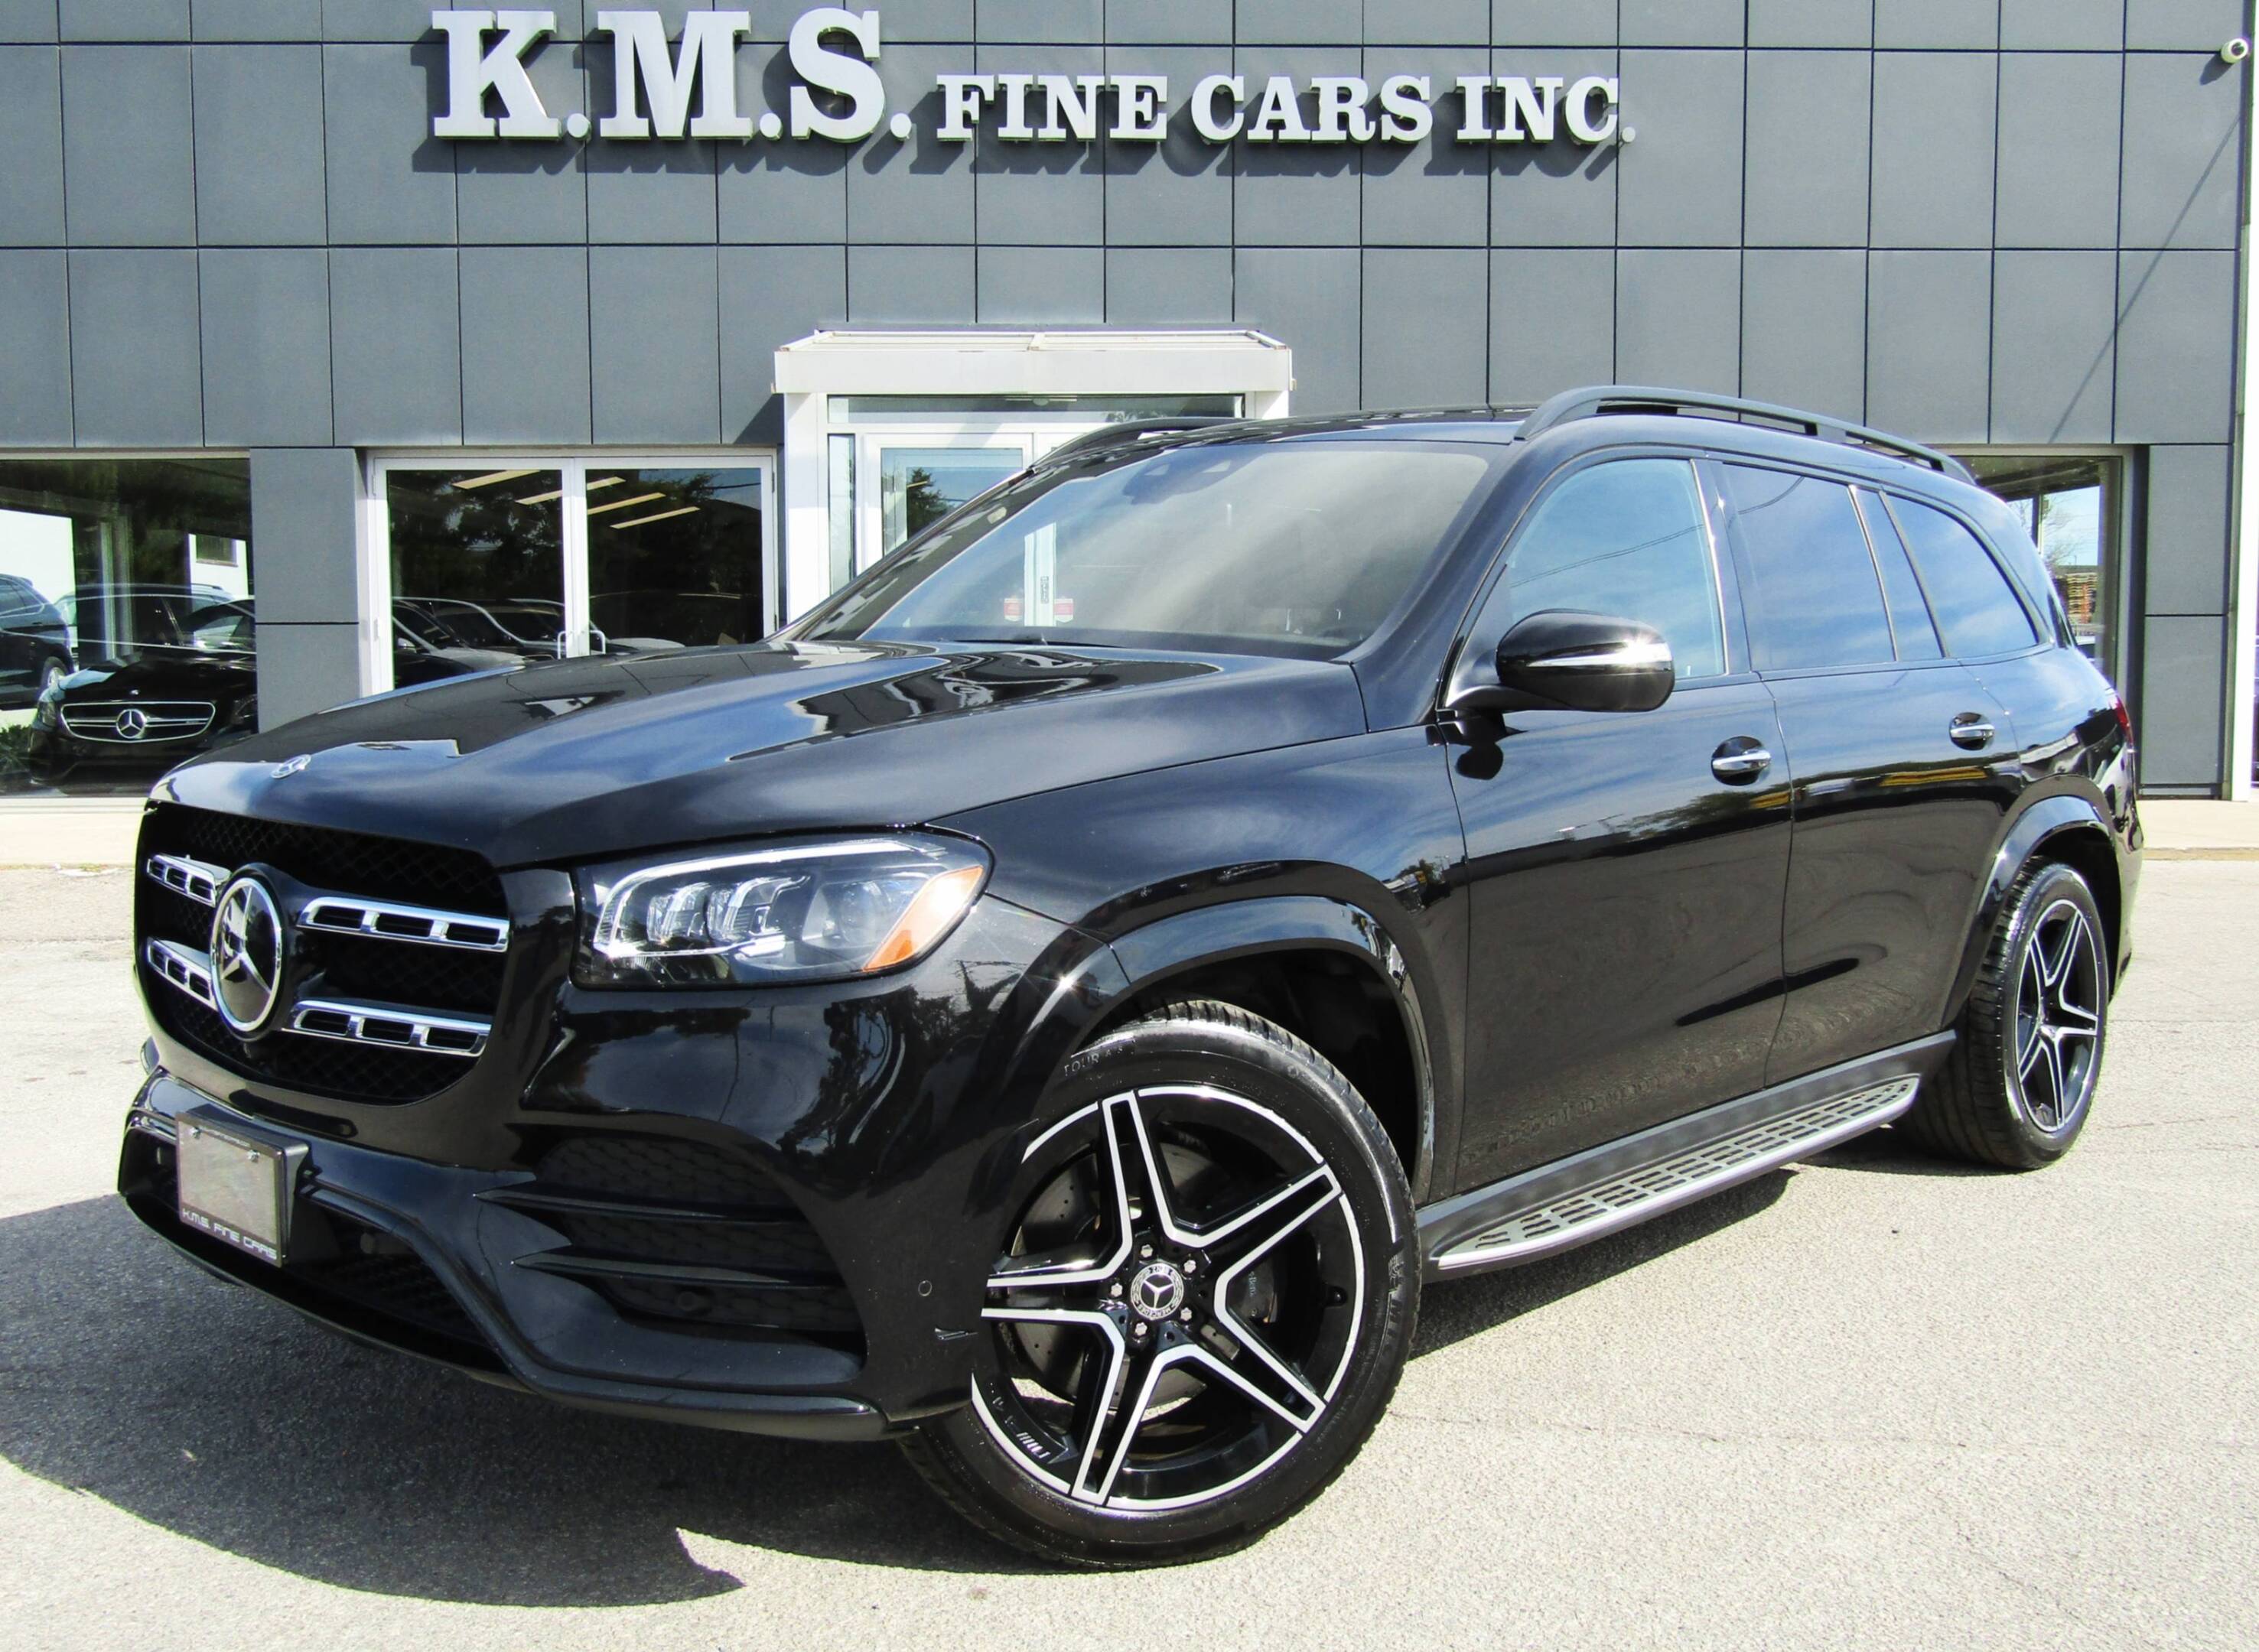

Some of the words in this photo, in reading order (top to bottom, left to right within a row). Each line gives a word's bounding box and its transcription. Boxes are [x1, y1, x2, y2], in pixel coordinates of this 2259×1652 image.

[432, 7, 912, 142] K.M.S.
[936, 74, 1168, 143] FINE
[1192, 75, 1433, 145] CARS
[1456, 76, 1636, 145] INC.
